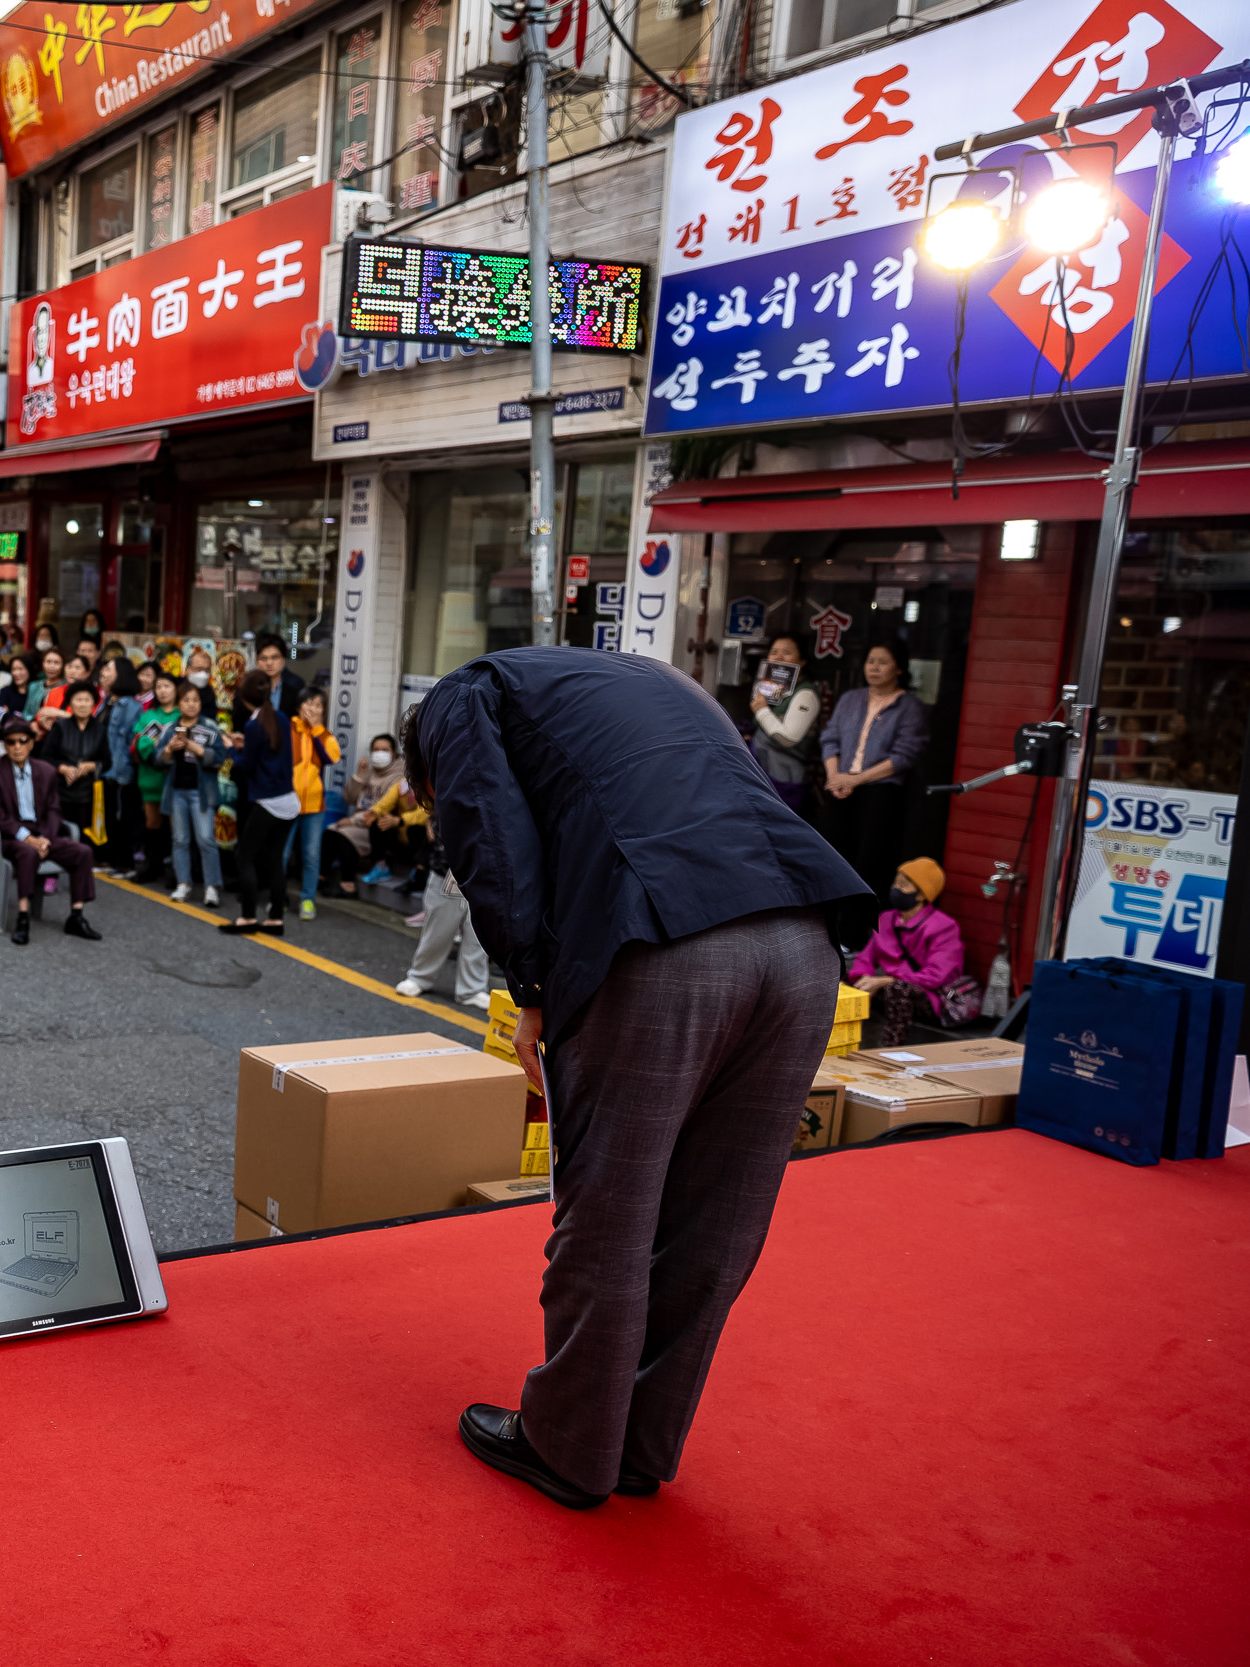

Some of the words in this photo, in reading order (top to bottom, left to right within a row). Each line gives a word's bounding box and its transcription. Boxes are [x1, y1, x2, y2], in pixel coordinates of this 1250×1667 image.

[94, 74, 139, 117] China
[136, 10, 233, 94] Restaurant
[705, 64, 914, 193] 원조
[65, 239, 307, 363] 牛肉面大王
[665, 246, 918, 348] 양꼬치거리
[652, 322, 920, 412] 선두주자
[342, 590, 363, 638] Dr.
[632, 590, 666, 653] Dr.
[811, 605, 852, 658] 食
[1113, 862, 1171, 888] 생방송
[36, 1230, 65, 1240] ELF
[32, 1317, 55, 1327] SAMSUNG
